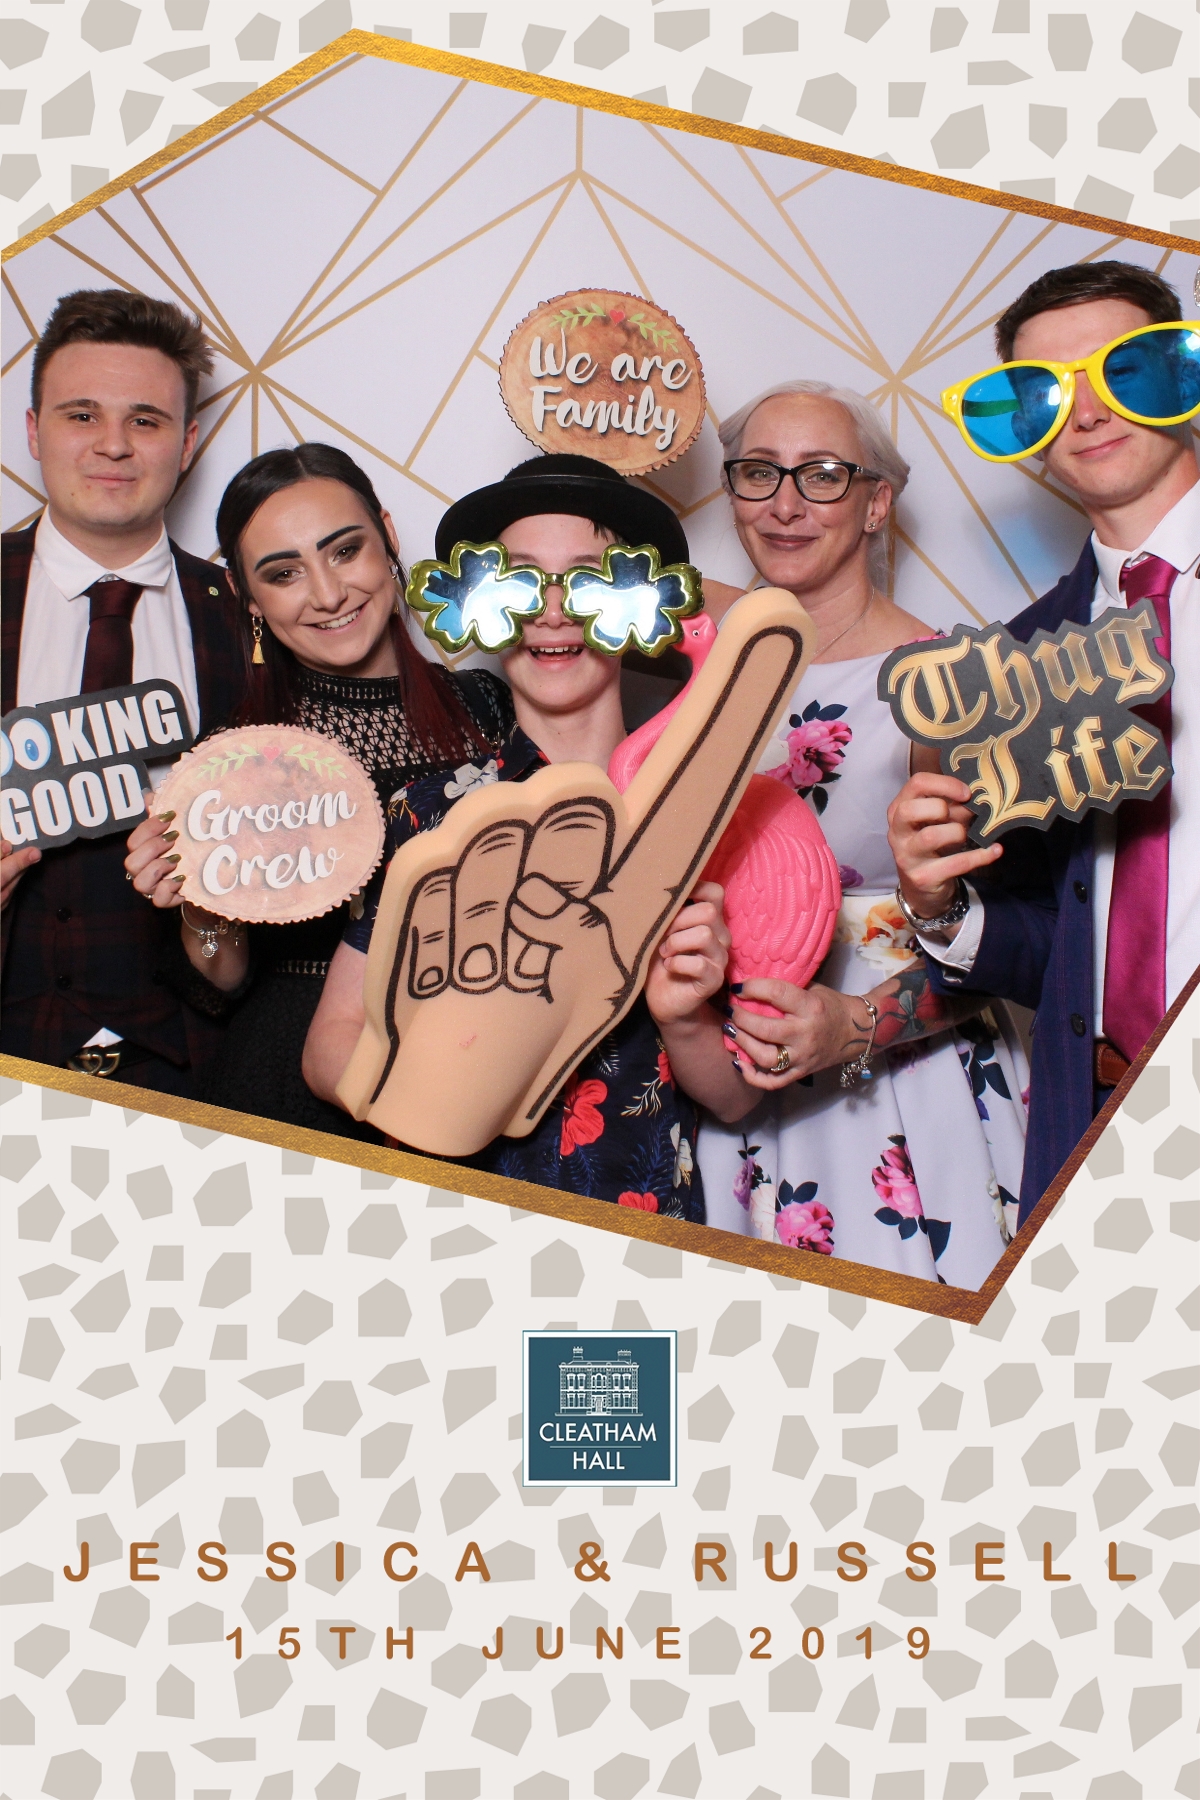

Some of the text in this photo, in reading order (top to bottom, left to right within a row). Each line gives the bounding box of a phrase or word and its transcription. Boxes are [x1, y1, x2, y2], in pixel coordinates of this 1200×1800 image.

[529, 328, 693, 390] We are
[529, 385, 680, 450] Family
[888, 609, 1166, 740] Thug
[0, 763, 146, 846] GOOD
[949, 716, 1165, 838] Life
[188, 790, 356, 842] Groom
[202, 844, 345, 896] Crew
